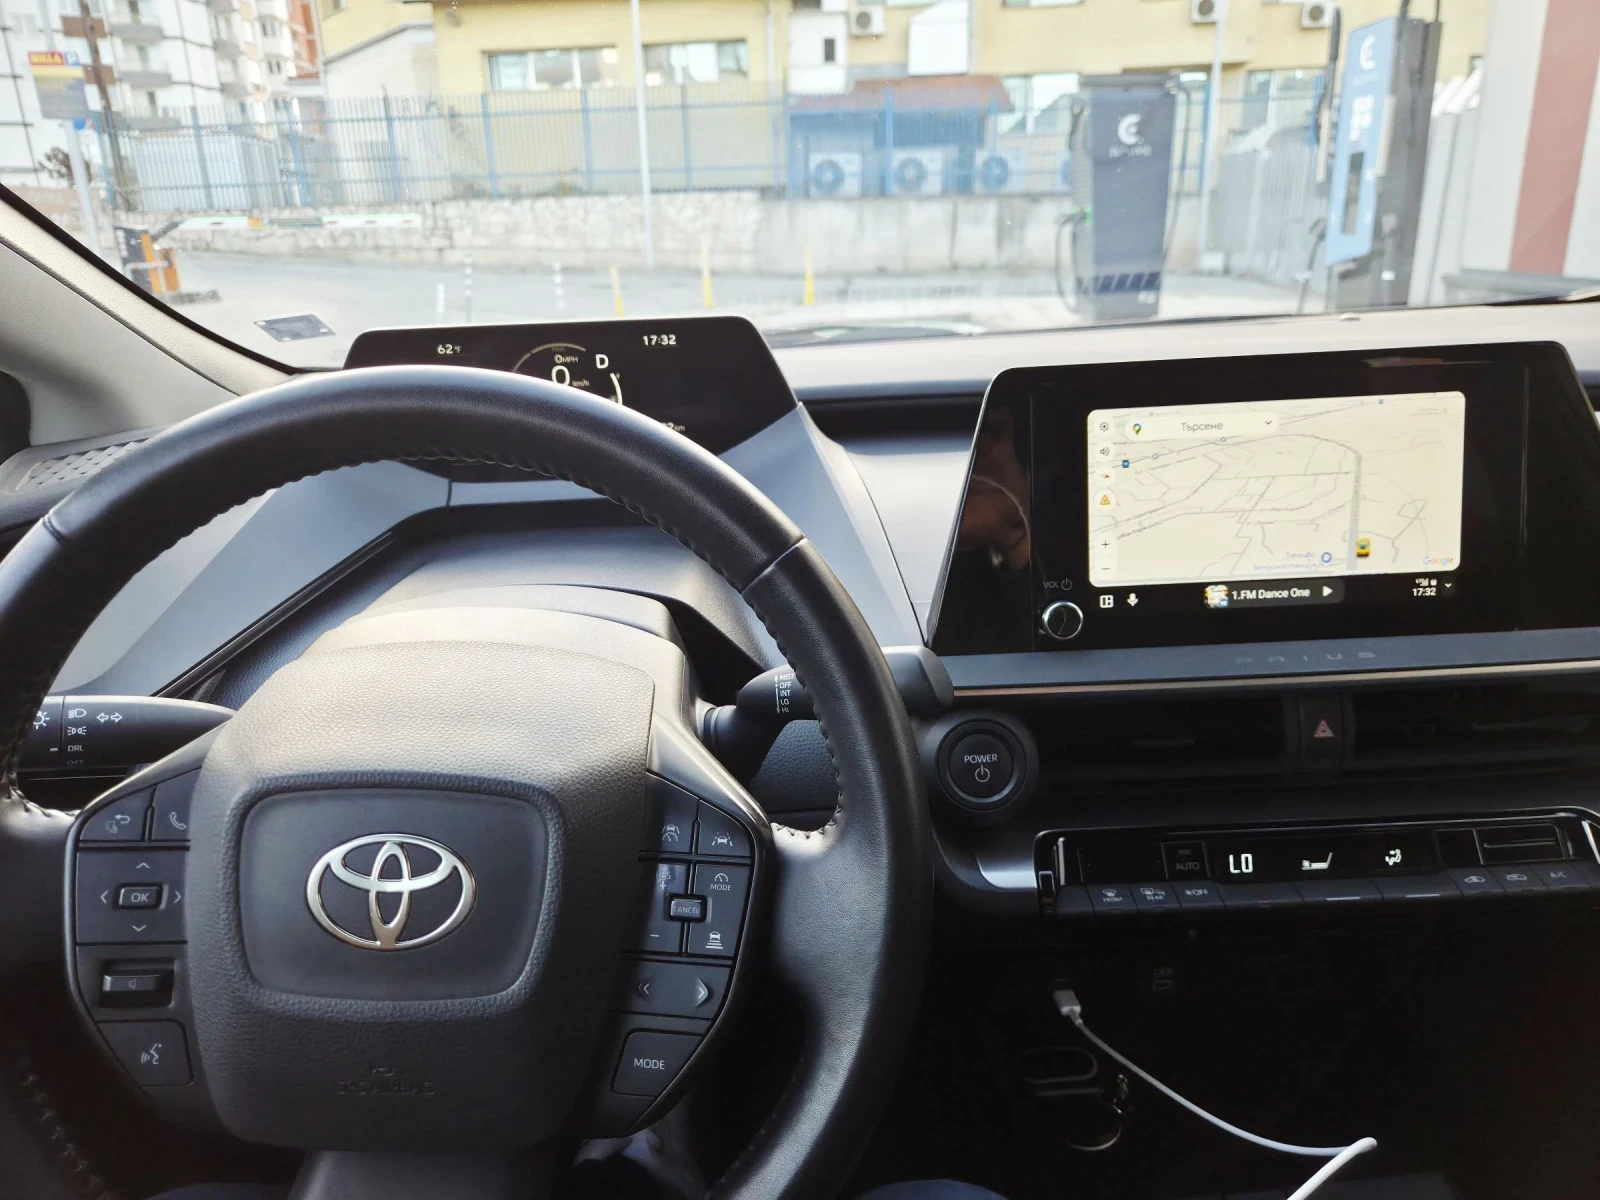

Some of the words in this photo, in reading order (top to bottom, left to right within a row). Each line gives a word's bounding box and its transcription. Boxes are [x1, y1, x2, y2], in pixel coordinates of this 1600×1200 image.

[643, 334, 676, 346] 17:32
[595, 353, 609, 369] D
[1181, 422, 1223, 433] Търсене
[1423, 556, 1455, 567] Google
[1043, 580, 1059, 589] VOL
[1232, 589, 1256, 600] 1.FM
[1258, 588, 1289, 599] Dance
[1290, 587, 1310, 598] One
[1412, 587, 1437, 597] 17:32
[779, 673, 795, 681] MIST
[779, 681, 792, 689] OFF
[779, 689, 791, 697] INT
[780, 698, 790, 706] LO
[67, 744, 84, 752] DRL
[964, 753, 998, 763] POWER
[1175, 861, 1200, 871] AUTO
[710, 883, 732, 891] MODE
[131, 892, 149, 903] OK
[673, 905, 700, 914] CANCEL
[633, 1057, 666, 1070] MODE
